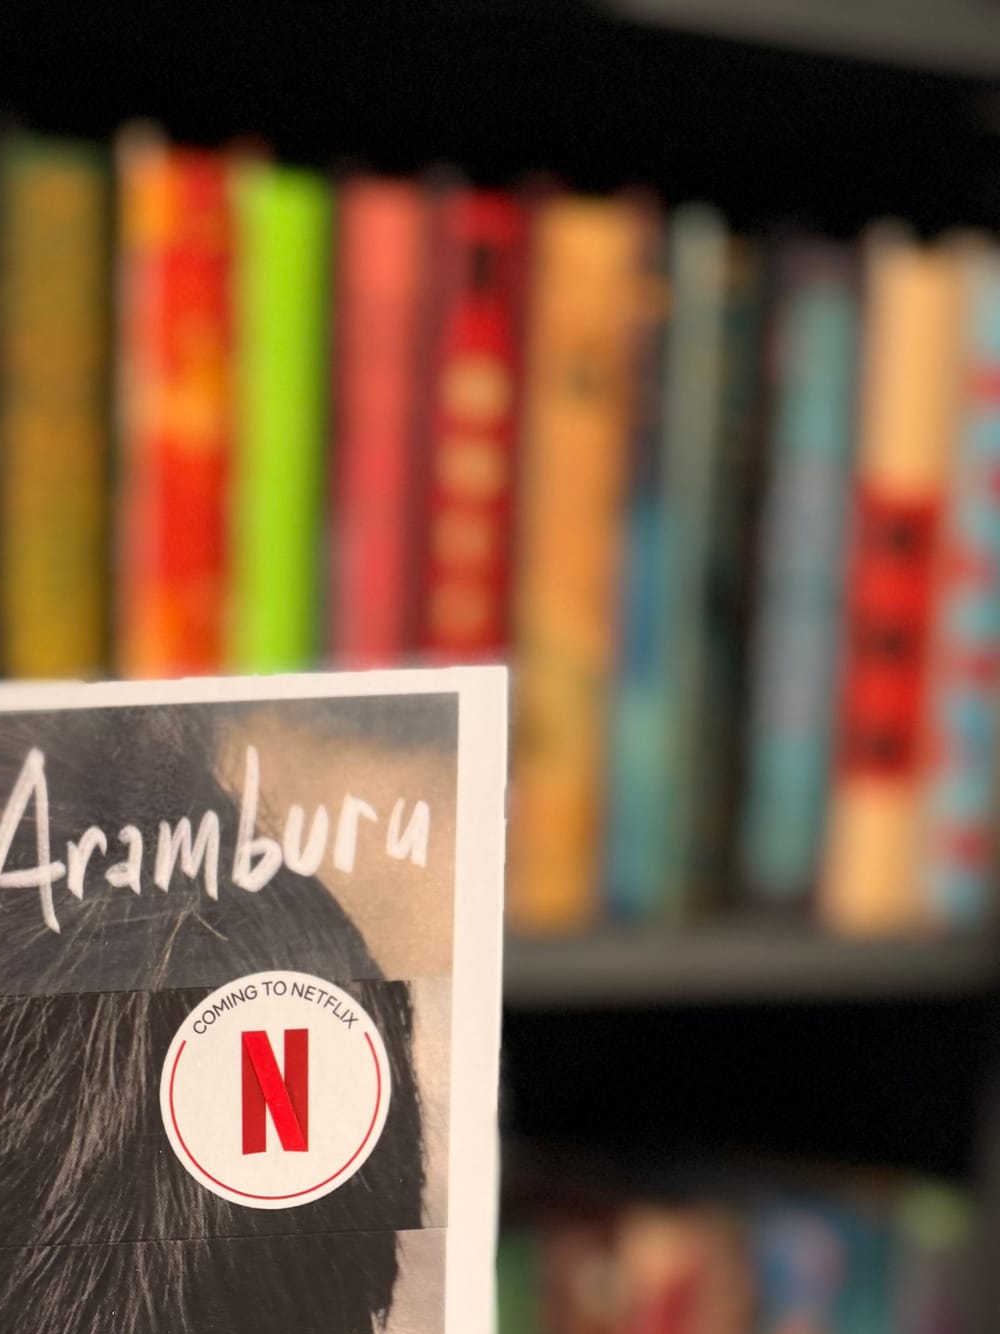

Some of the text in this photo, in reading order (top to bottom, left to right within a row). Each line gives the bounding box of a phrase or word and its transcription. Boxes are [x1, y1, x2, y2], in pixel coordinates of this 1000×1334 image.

[193, 980, 360, 1035] COMING TO NETFLIX
[241, 1028, 309, 1155] N
